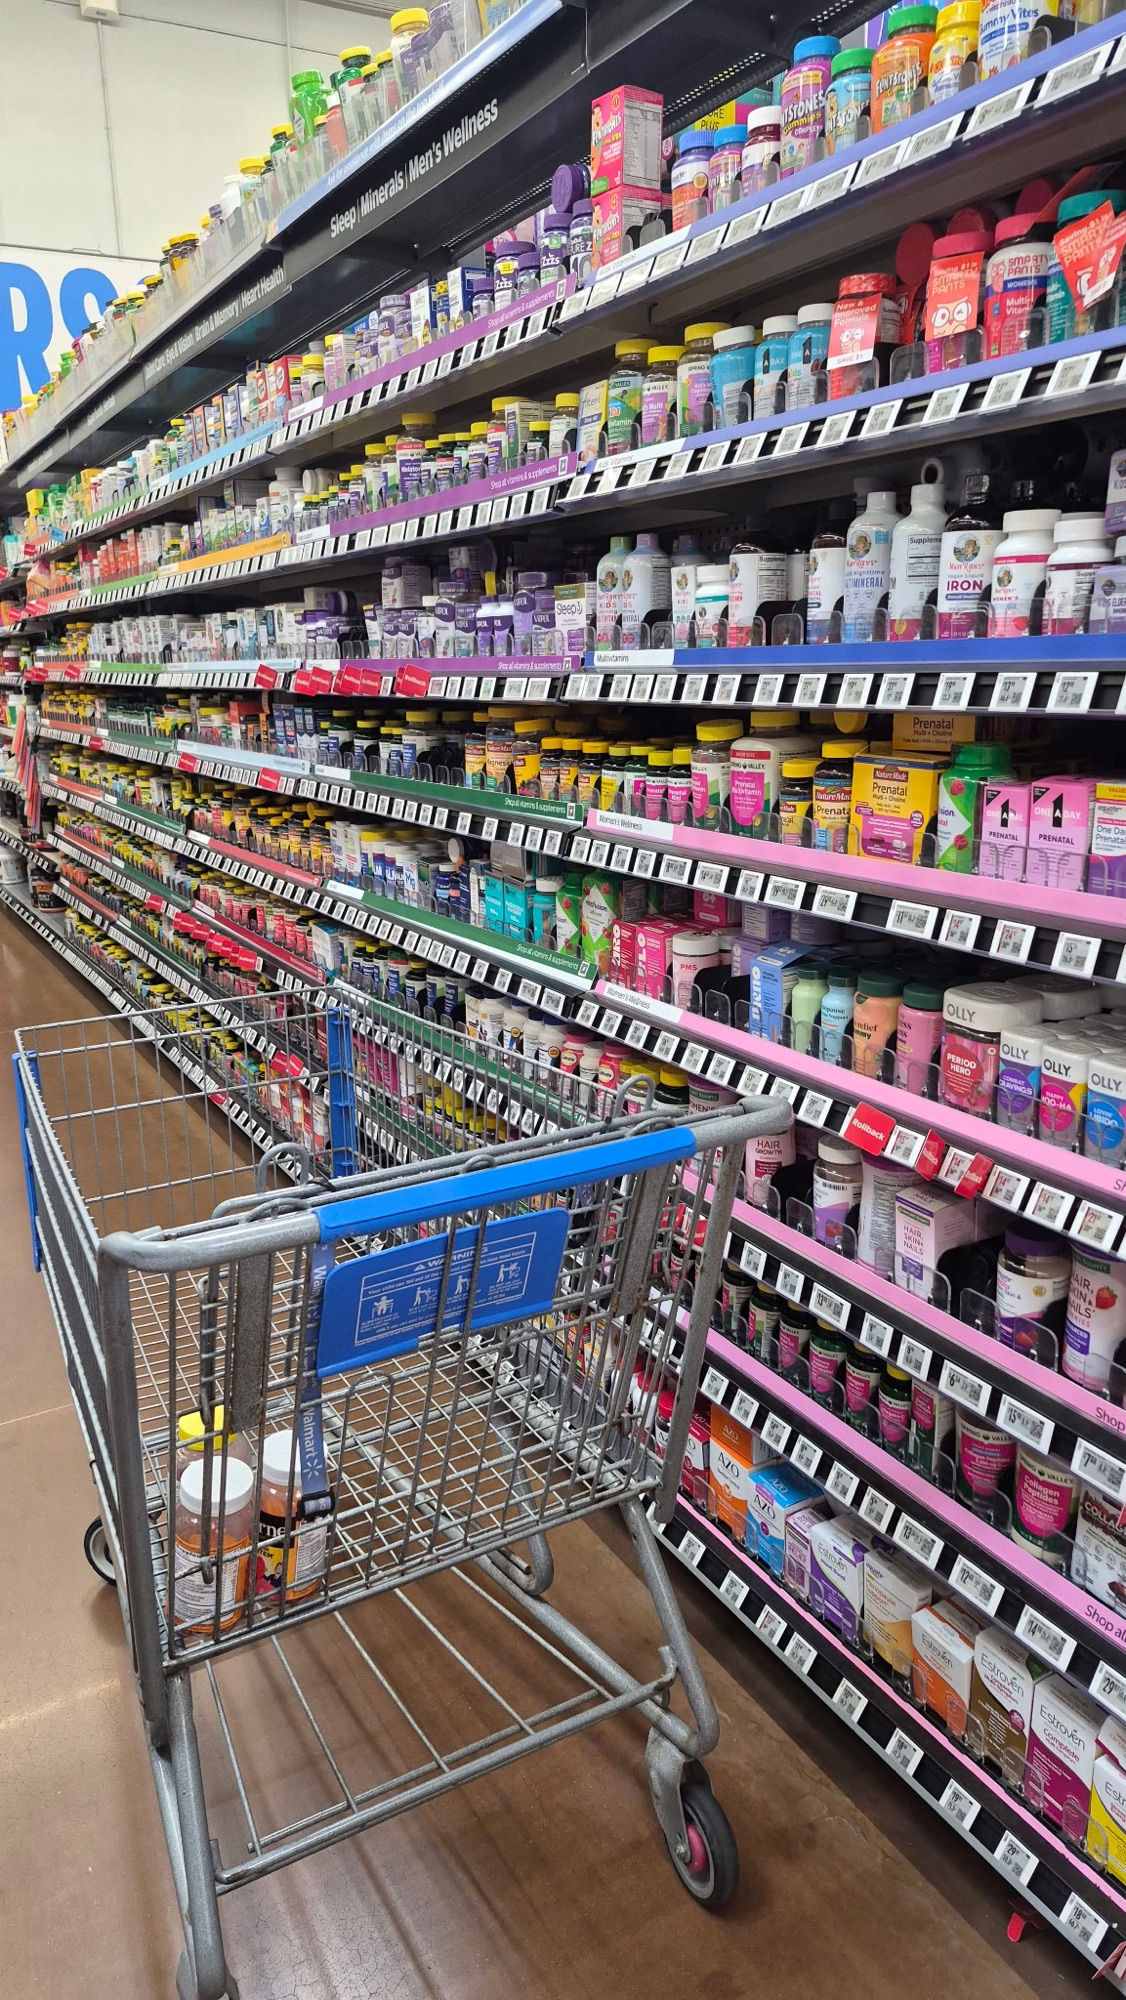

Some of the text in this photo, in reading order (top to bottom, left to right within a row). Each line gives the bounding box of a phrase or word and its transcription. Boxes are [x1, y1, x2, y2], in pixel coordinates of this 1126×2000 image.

[1011, 8, 1039, 20] Vites
[330, 98, 499, 238] Sleep Minerals Men's Wellness
[1008, 265, 1041, 277] PANTS
[241, 265, 284, 309] Heart Health
[932, 280, 966, 297] PANTS
[835, 305, 877, 318] Improved
[837, 303, 855, 312] New
[834, 315, 869, 328] Formula
[528, 464, 558, 480] supplements
[947, 579, 983, 592] IRON
[597, 653, 630, 663] Multivitamins
[534, 661, 562, 671] supplements
[404, 675, 427, 687] Rollback
[913, 717, 955, 730] Prenatal
[735, 779, 756, 789] Prenatal
[872, 781, 908, 797] Prenatal
[872, 793, 884, 801] Multi
[538, 803, 566, 814] supplements
[986, 810, 1000, 818] ONE
[1034, 806, 1081, 820] ONE A DAY
[620, 818, 643, 832] Wellness
[1097, 825, 1112, 834] One
[989, 830, 1019, 842] PRENATAL
[1039, 833, 1075, 846] PRENATAL
[551, 956, 579, 971] supplements
[680, 963, 698, 971] PMS
[607, 987, 651, 1010] Women's Wellness
[946, 1003, 977, 1023] OLLY
[857, 1022, 878, 1032] relief
[1002, 1043, 1029, 1060] OLLY
[947, 1053, 977, 1069] PERIOD
[1043, 1058, 1071, 1077] OLLY
[950, 1063, 971, 1077] HERO
[999, 1079, 1033, 1095] CRAVINGS
[1003, 1075, 1025, 1086] COMBAT
[1091, 1073, 1122, 1092] OLLY
[1046, 1090, 1064, 1101] HAPPY
[1090, 1112, 1118, 1127] LIBIDO
[851, 1117, 885, 1142] Rollback
[754, 1147, 783, 1156] GROWTH
[757, 1139, 780, 1150] HAIR
[904, 1240, 924, 1256] NAILS
[1095, 1406, 1126, 1433] Shop
[723, 1424, 739, 1440] AZO
[718, 1451, 740, 1478] AZO
[772, 1478, 789, 1493] AZO
[1024, 1475, 1060, 1498] Collagen
[1024, 1482, 1059, 1505] Peptides
[754, 1493, 776, 1520] AZO
[817, 1542, 848, 1574] Estroven
[1085, 1604, 1114, 1632] Shop
[921, 1633, 953, 1669] Estroven
[980, 1652, 1024, 1698] Estroven
[1039, 1704, 1086, 1751] Estroven
[1043, 1727, 1080, 1763] Complete
